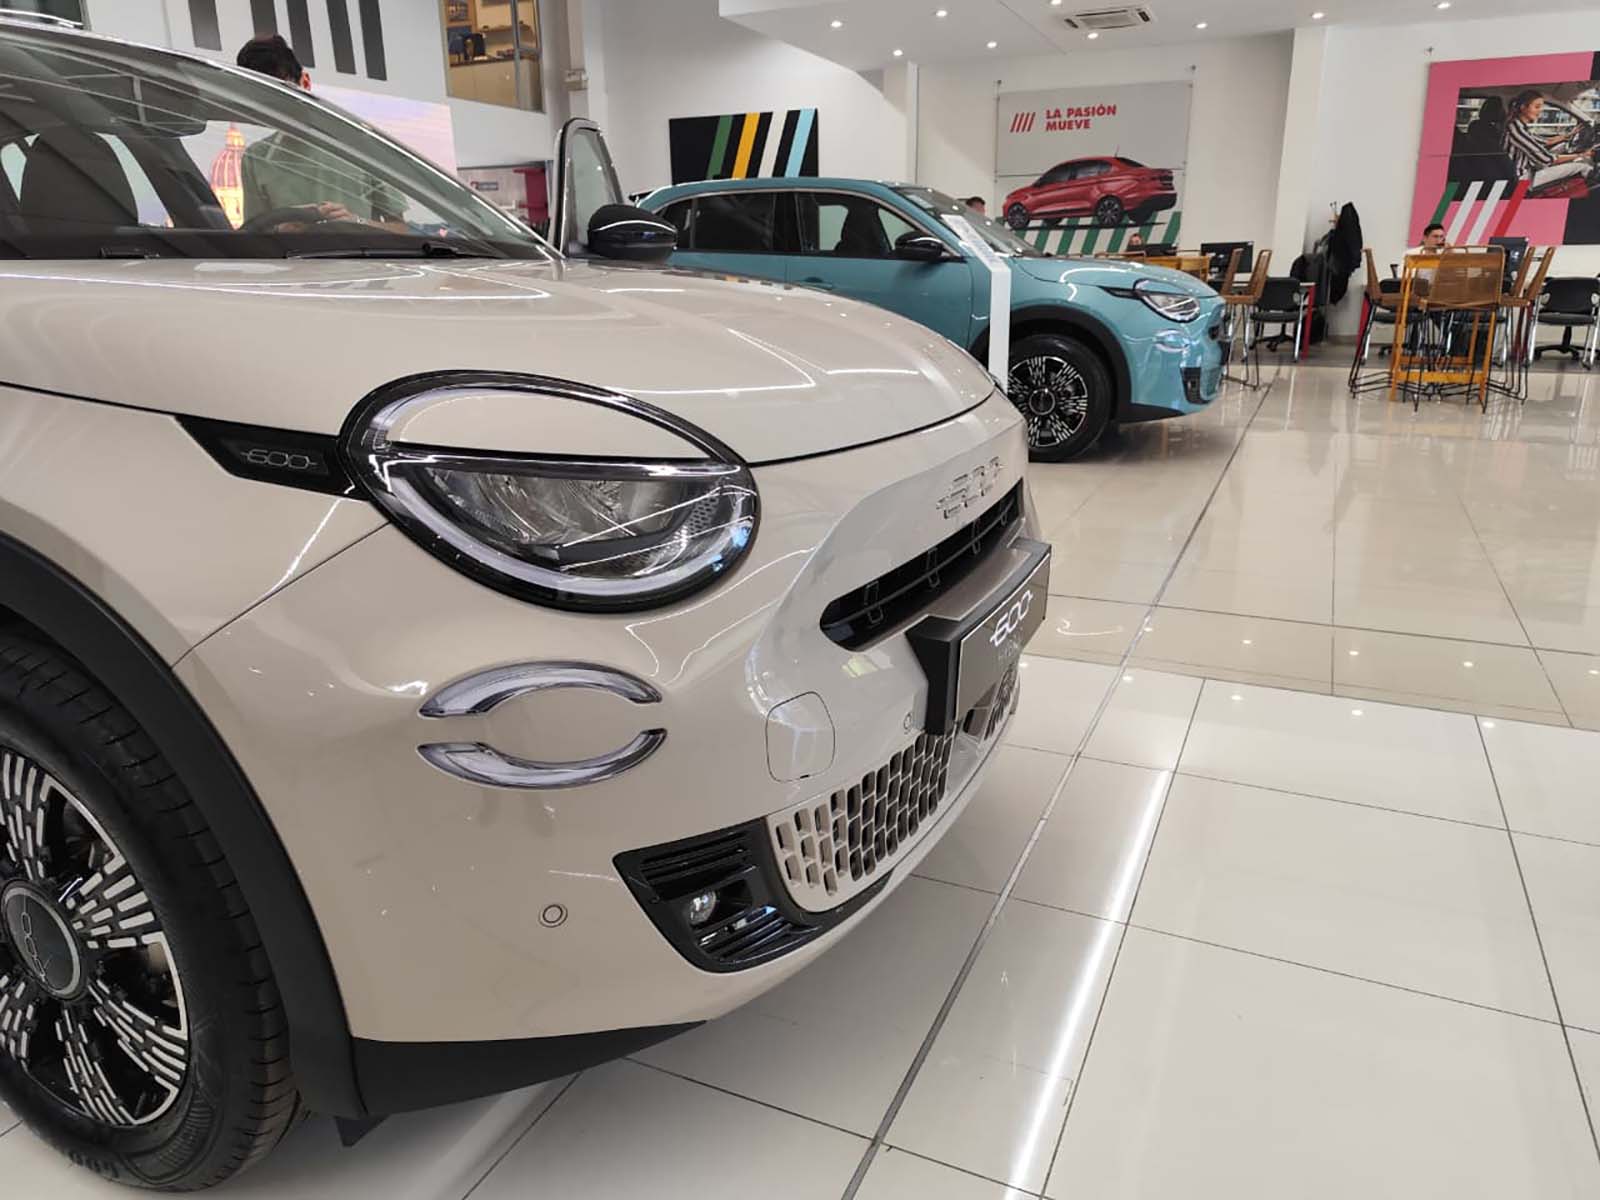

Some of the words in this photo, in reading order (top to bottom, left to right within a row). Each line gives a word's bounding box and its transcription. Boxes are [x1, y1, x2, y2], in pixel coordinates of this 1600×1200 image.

[1046, 108, 1061, 119] LA
[1067, 104, 1116, 118] PASIÓN
[1046, 118, 1091, 131] MUEVE
[241, 448, 317, 469] 600
[990, 590, 1034, 647] 600
